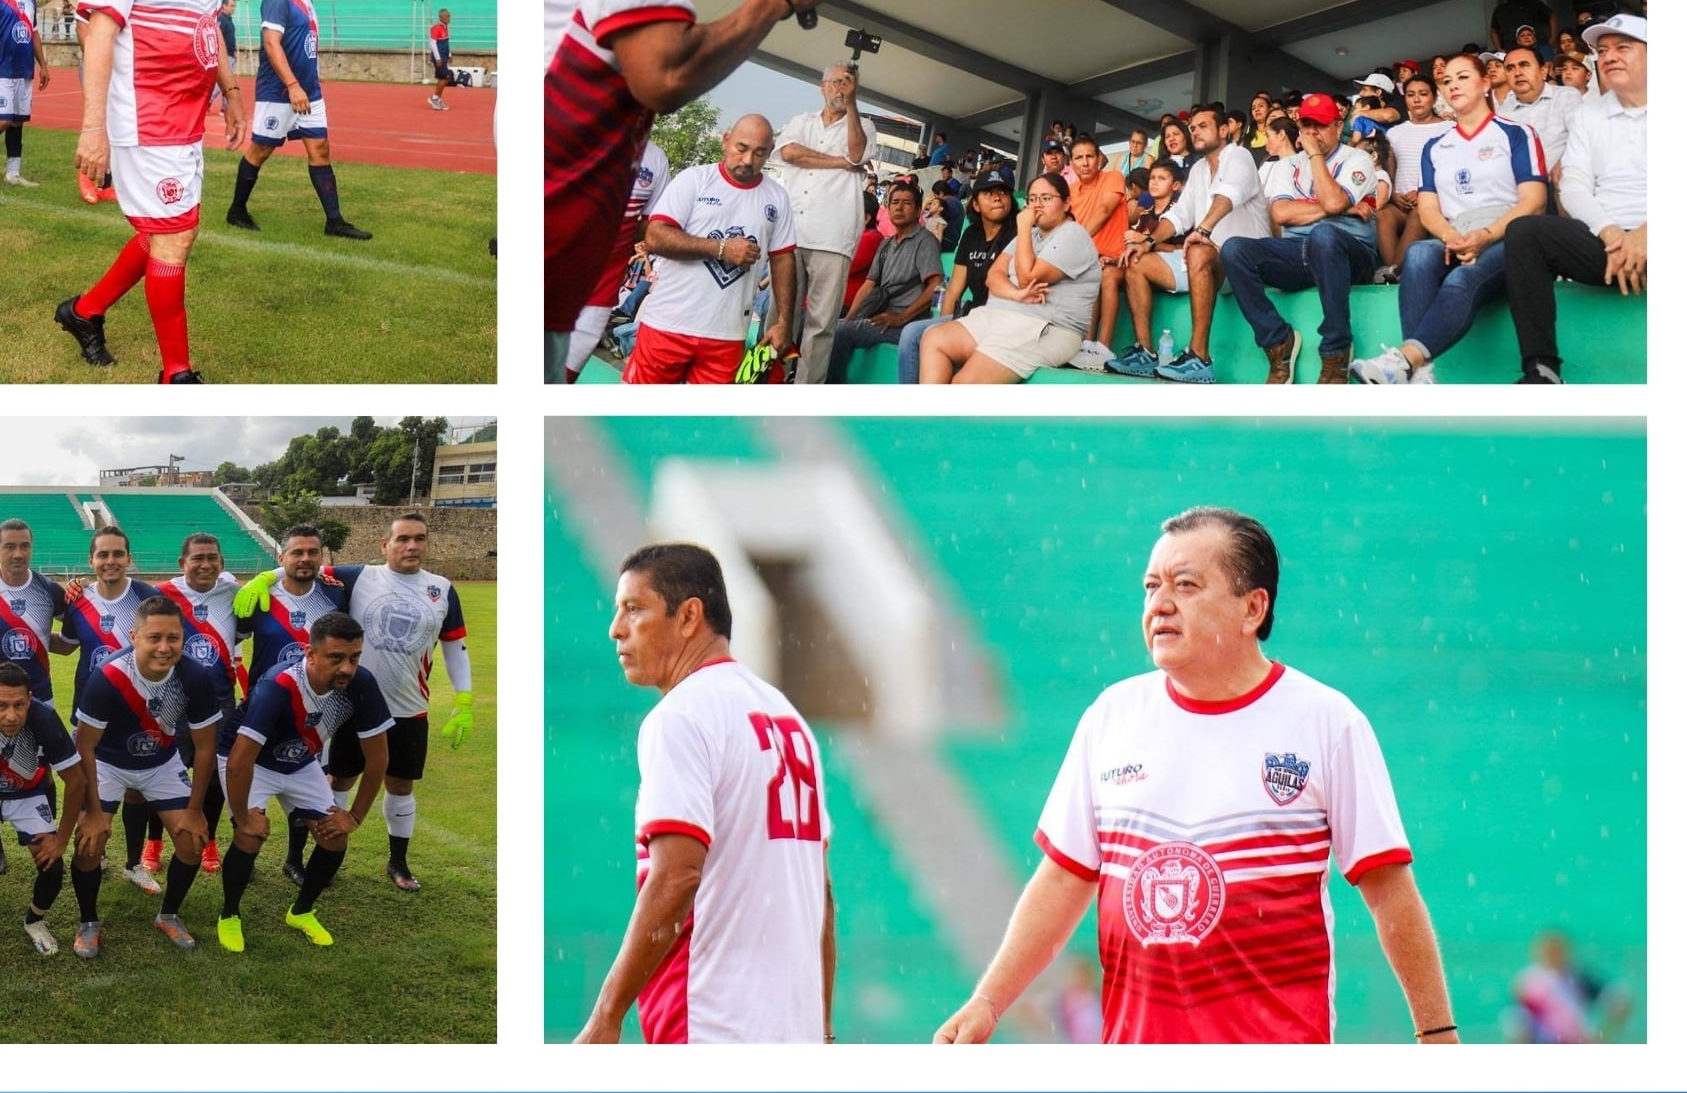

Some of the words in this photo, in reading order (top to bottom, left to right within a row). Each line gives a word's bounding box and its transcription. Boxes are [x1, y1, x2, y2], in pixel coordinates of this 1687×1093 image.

[747, 711, 822, 842] 28
[1265, 769, 1305, 792] AGUILAS
[1197, 877, 1221, 932] GUERRERO
